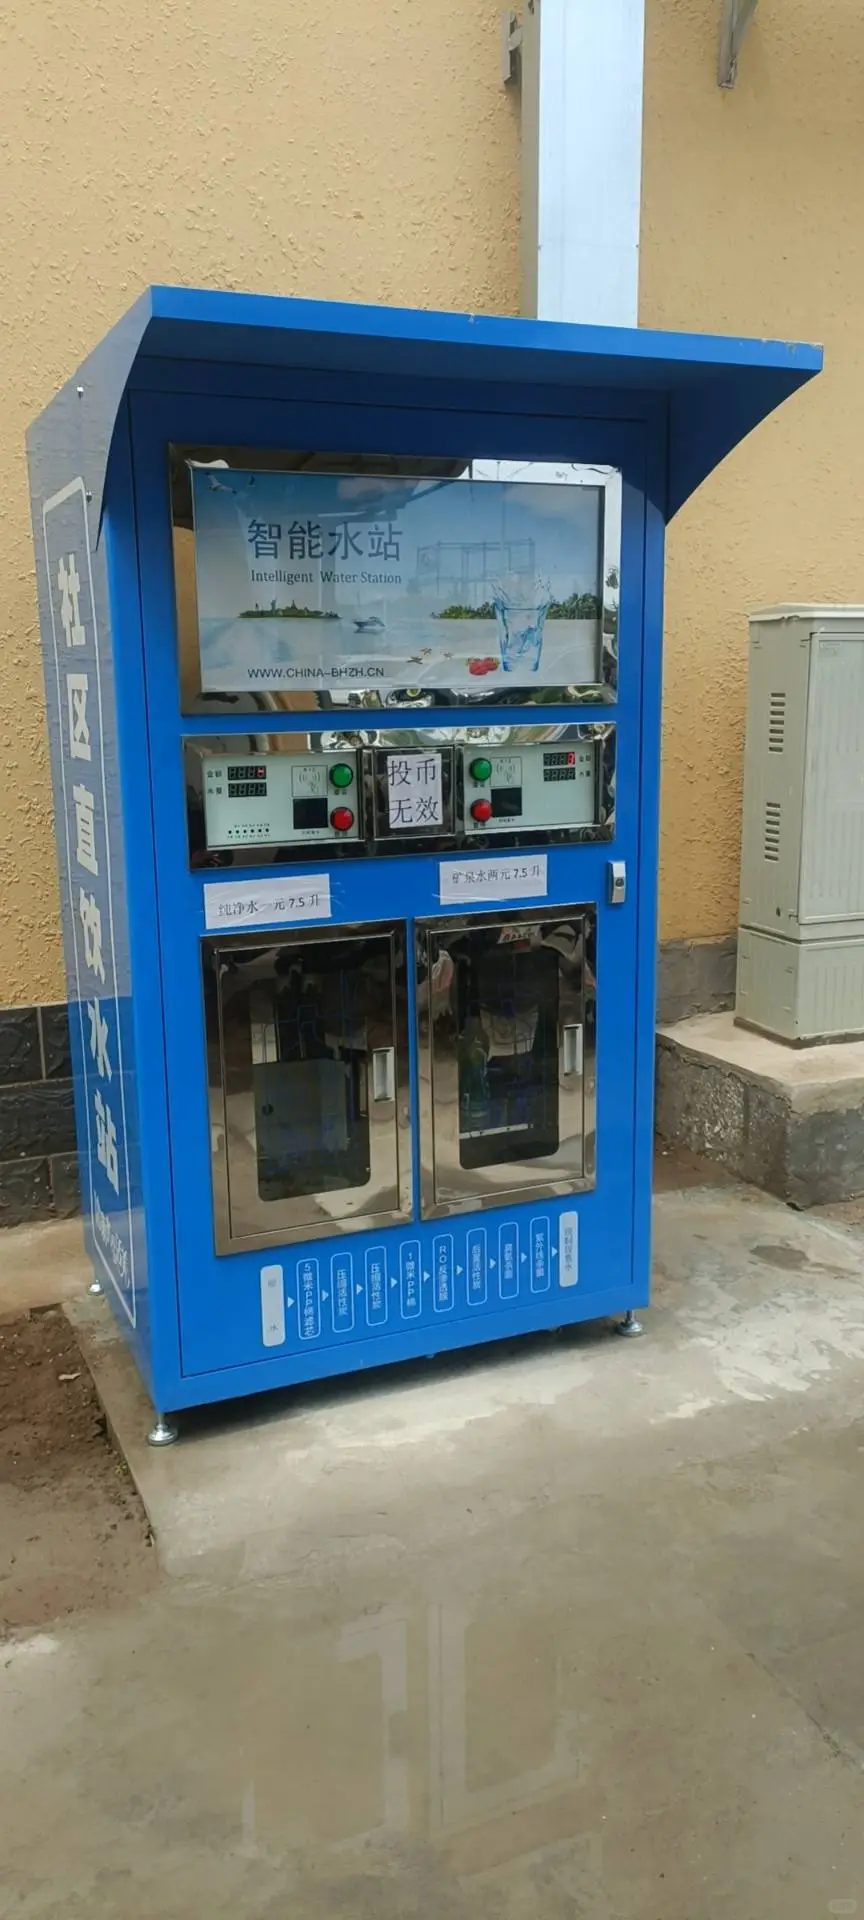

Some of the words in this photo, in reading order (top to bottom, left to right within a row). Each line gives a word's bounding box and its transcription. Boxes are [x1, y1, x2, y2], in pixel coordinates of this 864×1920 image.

[247, 519, 404, 562] 智能水站
[251, 569, 314, 585] Intelligent
[320, 570, 359, 584] Water
[361, 570, 402, 585] Station
[388, 758, 437, 787] 投币
[390, 796, 440, 825] 无效
[57, 552, 121, 1196] 社区直饮水站
